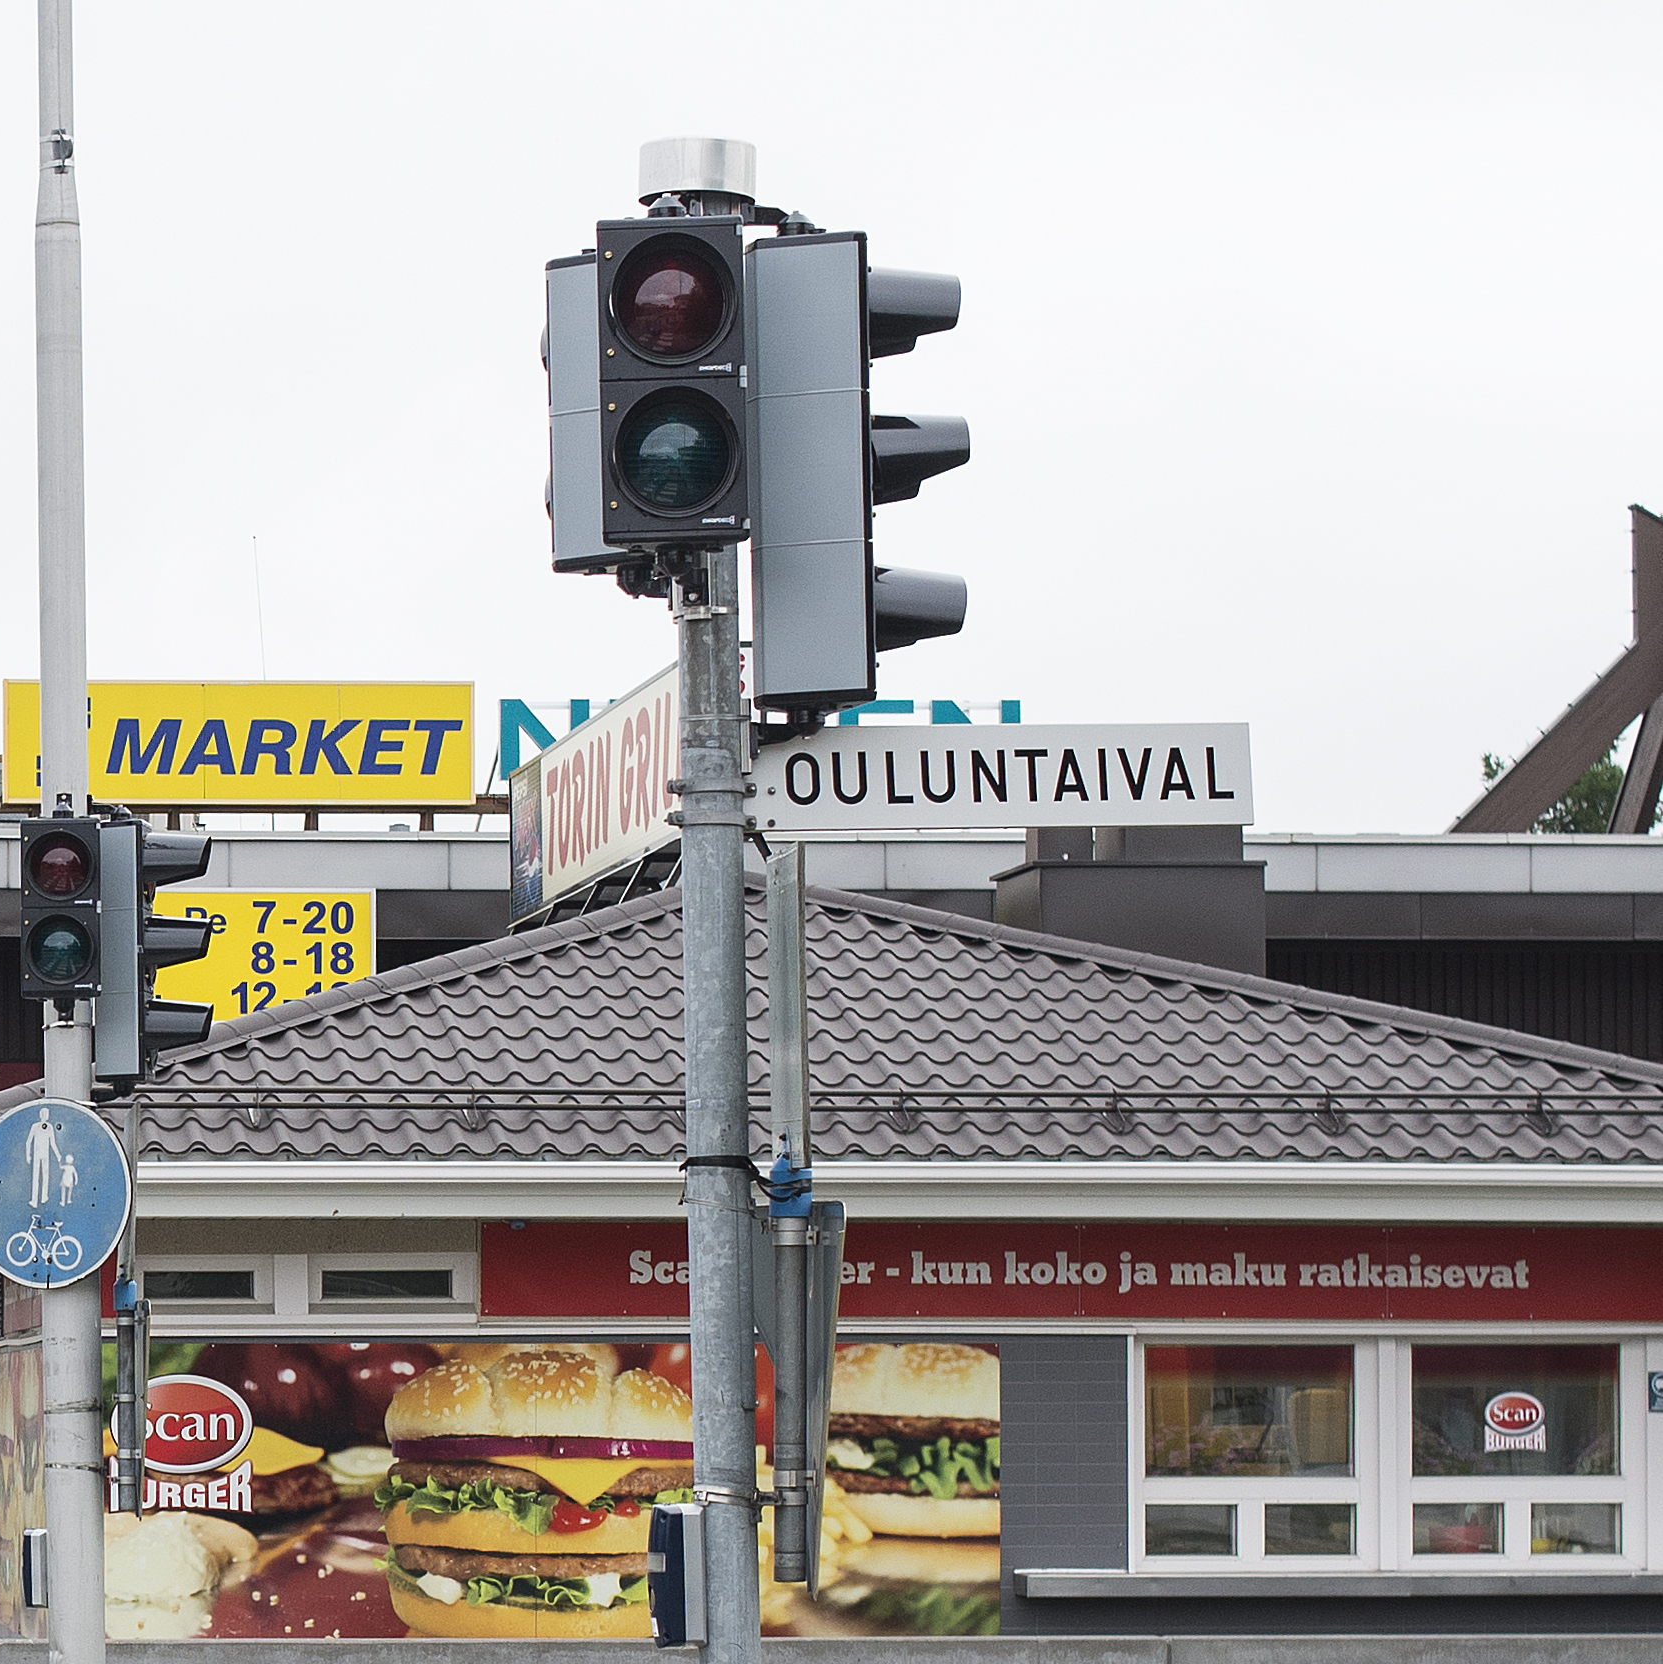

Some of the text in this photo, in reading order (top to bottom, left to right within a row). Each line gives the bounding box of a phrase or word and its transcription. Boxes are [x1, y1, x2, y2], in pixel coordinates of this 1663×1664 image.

[105, 718, 463, 776] MARKET
[547, 730, 611, 877] TORIN
[620, 691, 681, 836] GRIL
[784, 746, 1236, 806] OULUNTAIVAL
[629, 1249, 690, 1285] Sca
[911, 1250, 992, 1286] kun
[1004, 1251, 1106, 1287] koko
[1118, 1251, 1157, 1294] ja
[1169, 1252, 1287, 1288] maku
[1299, 1253, 1530, 1290] ratkaisevat
[1492, 1403, 1538, 1423] Scan
[1484, 1424, 1546, 1454] BURGER
